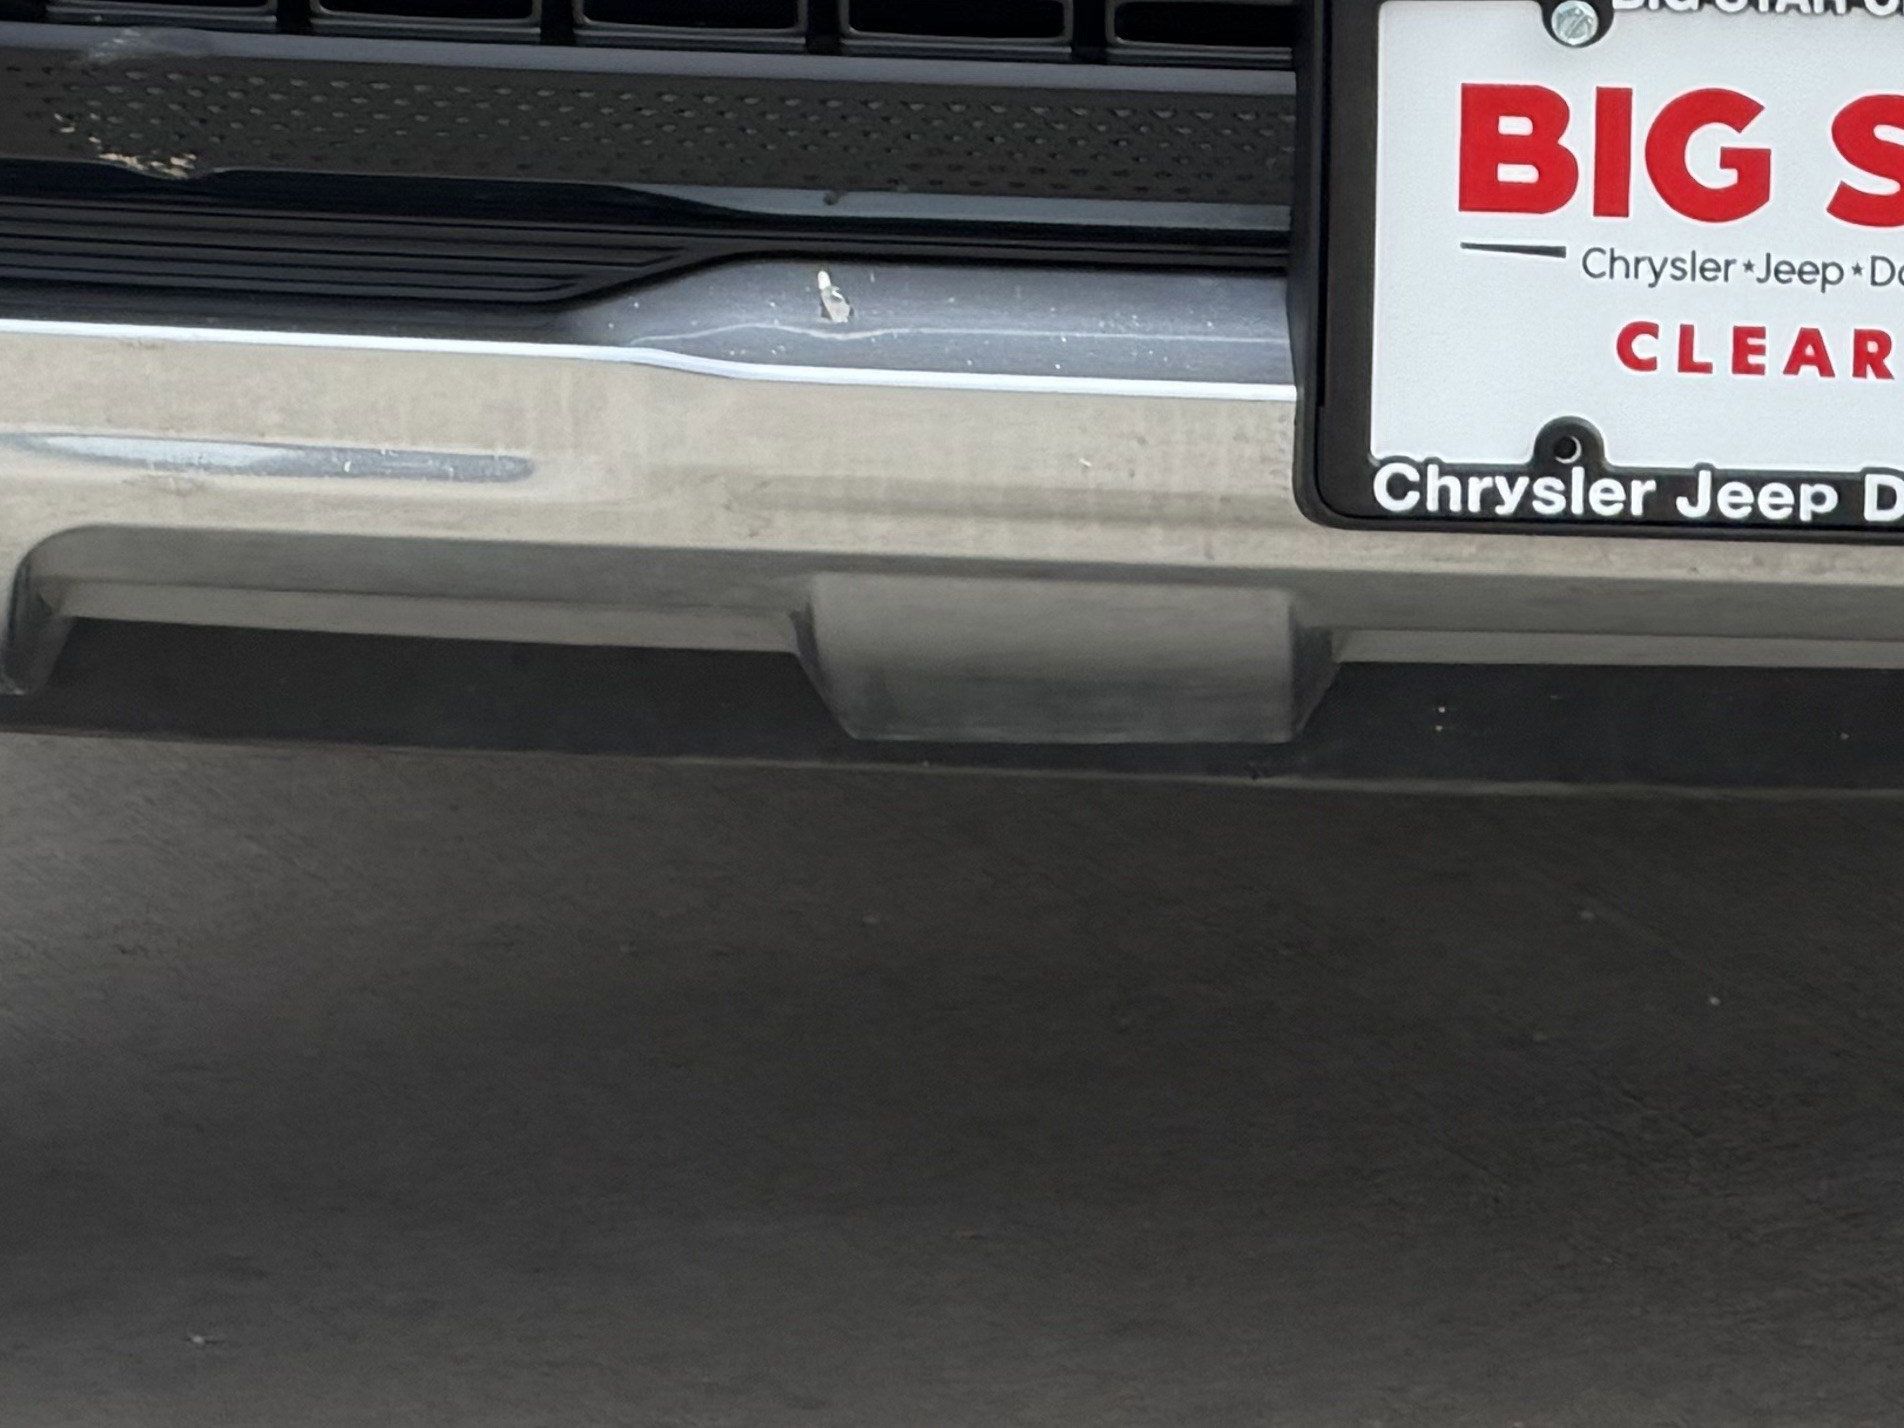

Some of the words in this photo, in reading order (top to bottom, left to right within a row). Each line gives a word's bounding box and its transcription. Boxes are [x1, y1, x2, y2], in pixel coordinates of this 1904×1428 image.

[1457, 82, 1772, 223] BIG
[1581, 246, 1738, 291] Chrysler
[1755, 253, 1843, 293] Jeep
[1616, 321, 1894, 380] CLEAR
[1372, 463, 1656, 521] Chrysler
[1676, 471, 1838, 524] Jeep
